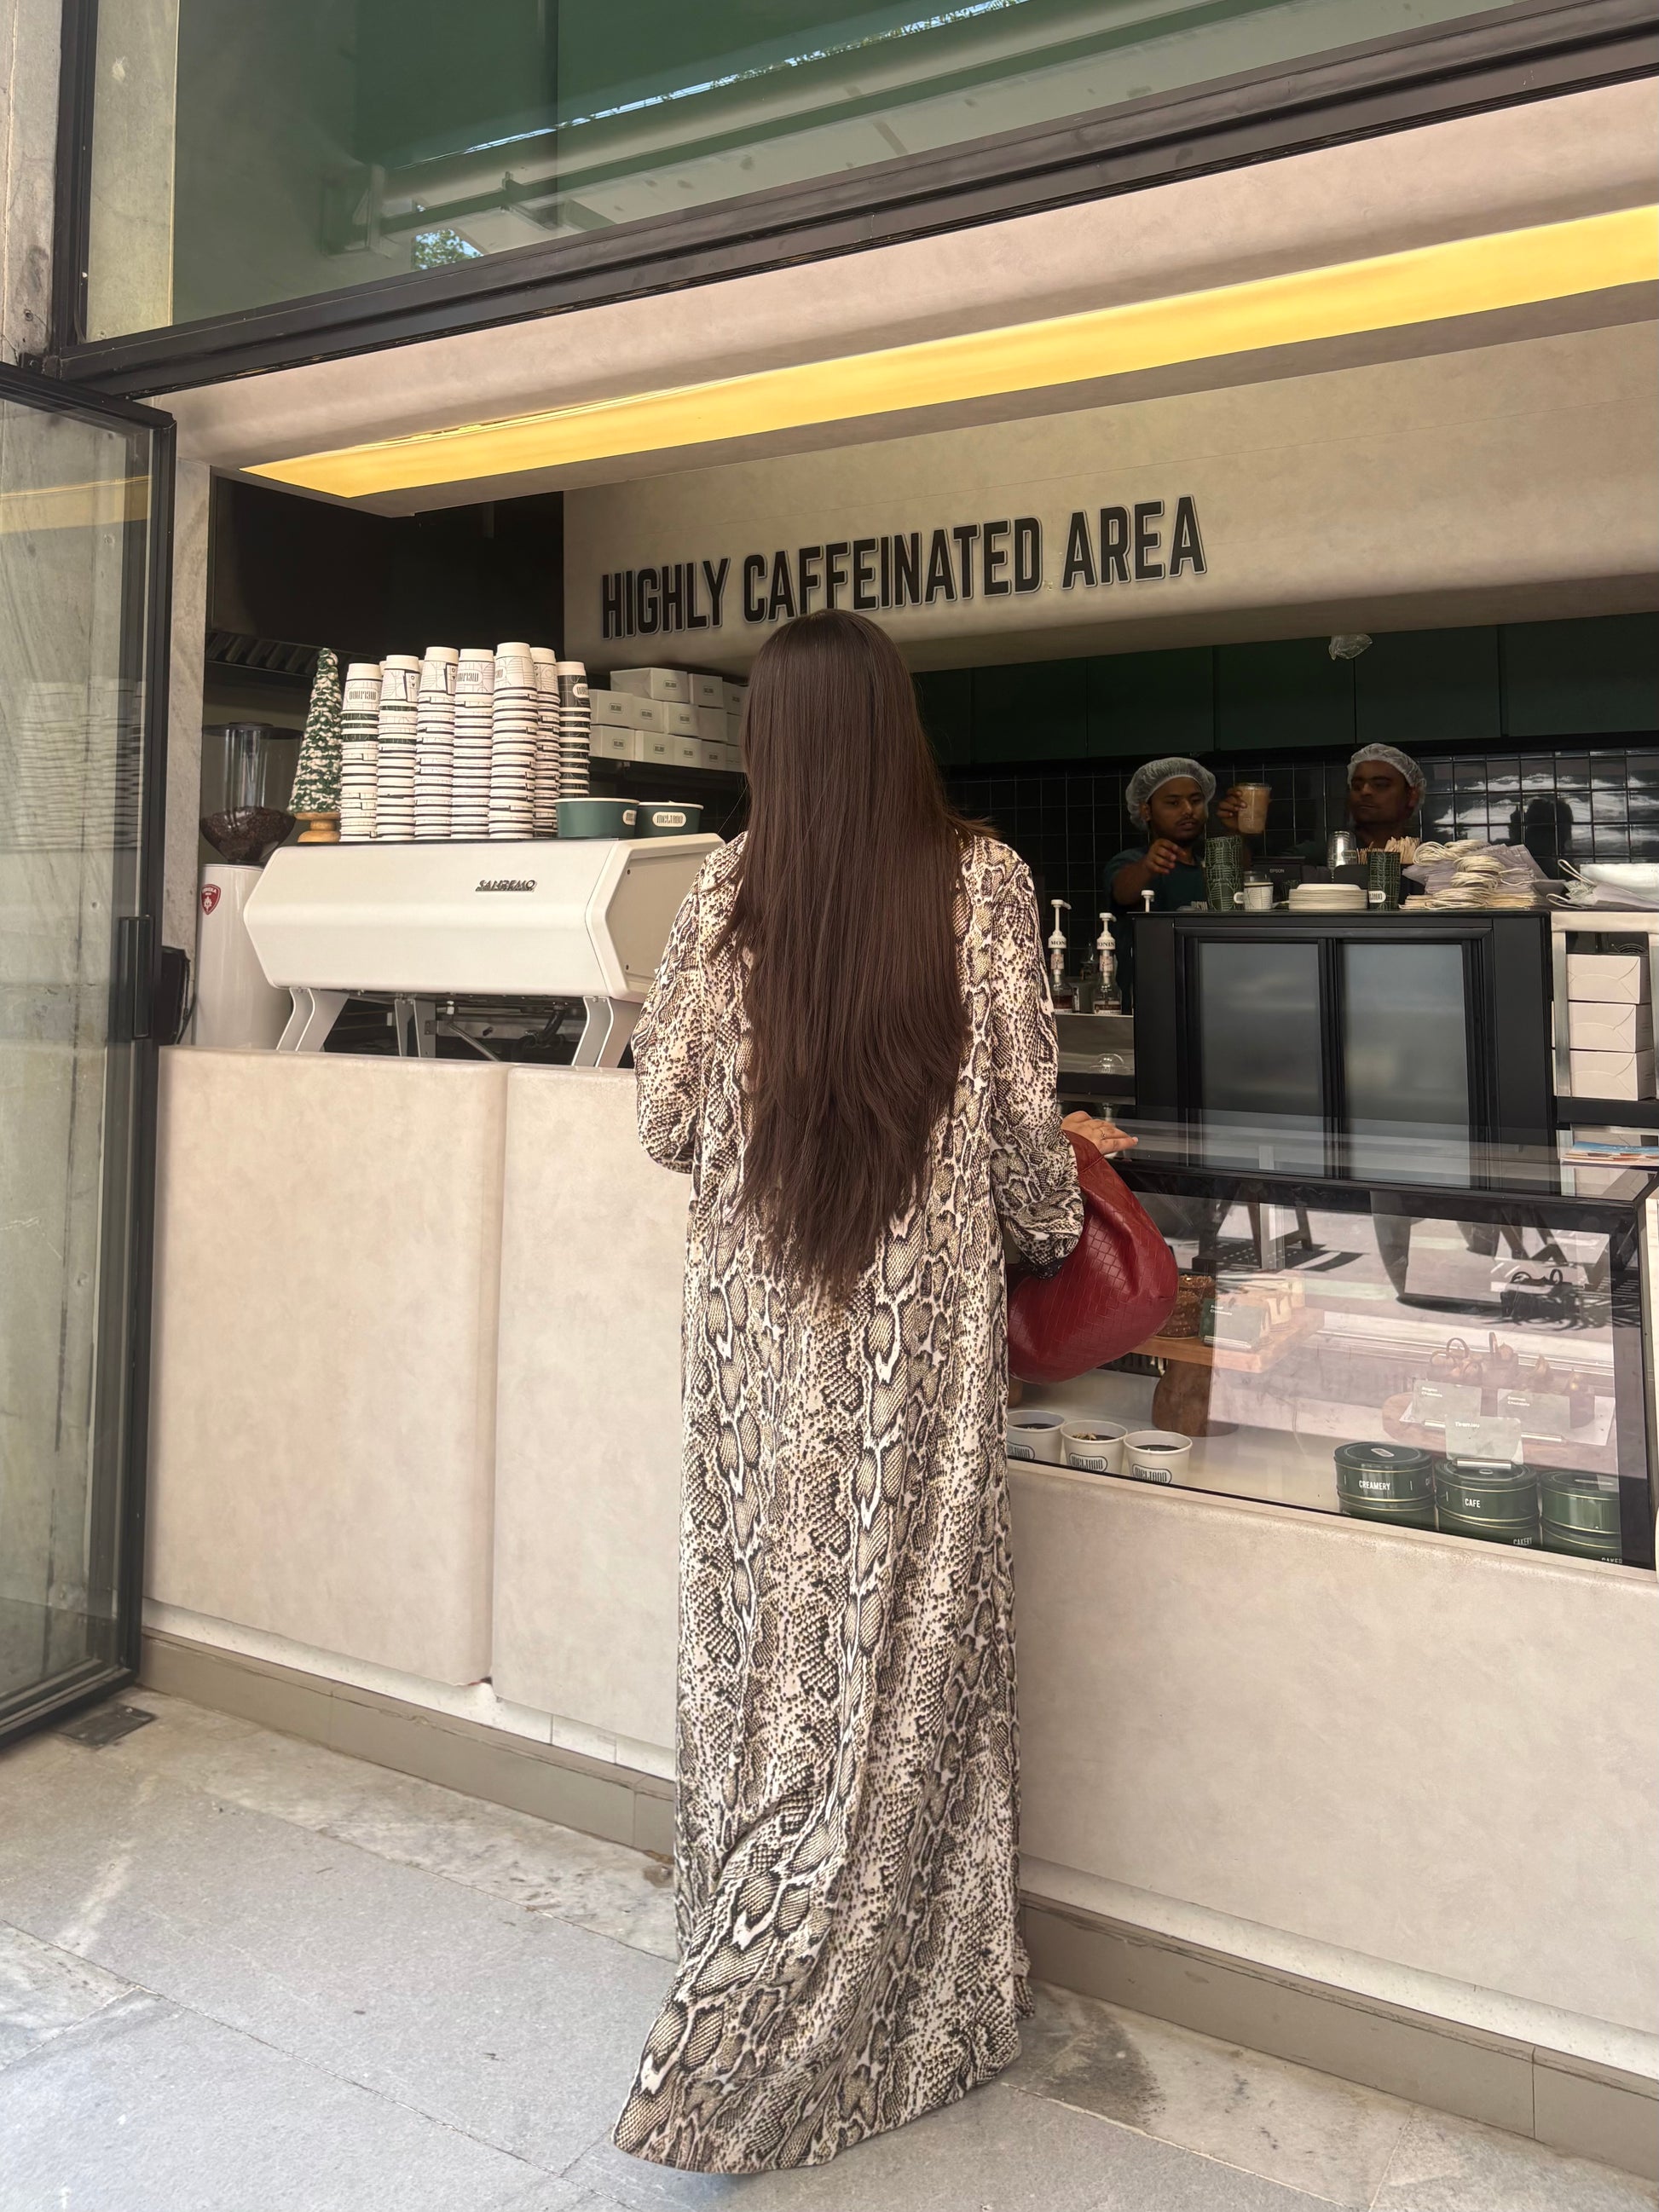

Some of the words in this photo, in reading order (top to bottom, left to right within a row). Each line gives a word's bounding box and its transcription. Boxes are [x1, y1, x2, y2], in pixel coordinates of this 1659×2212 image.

[602, 557, 731, 639] HIGHLY
[743, 516, 1043, 623] CAFFEINATED
[1060, 494, 1207, 591] AREA
[1359, 1480, 1391, 1491] CREAMERY
[1465, 1498, 1481, 1508] CAFE
